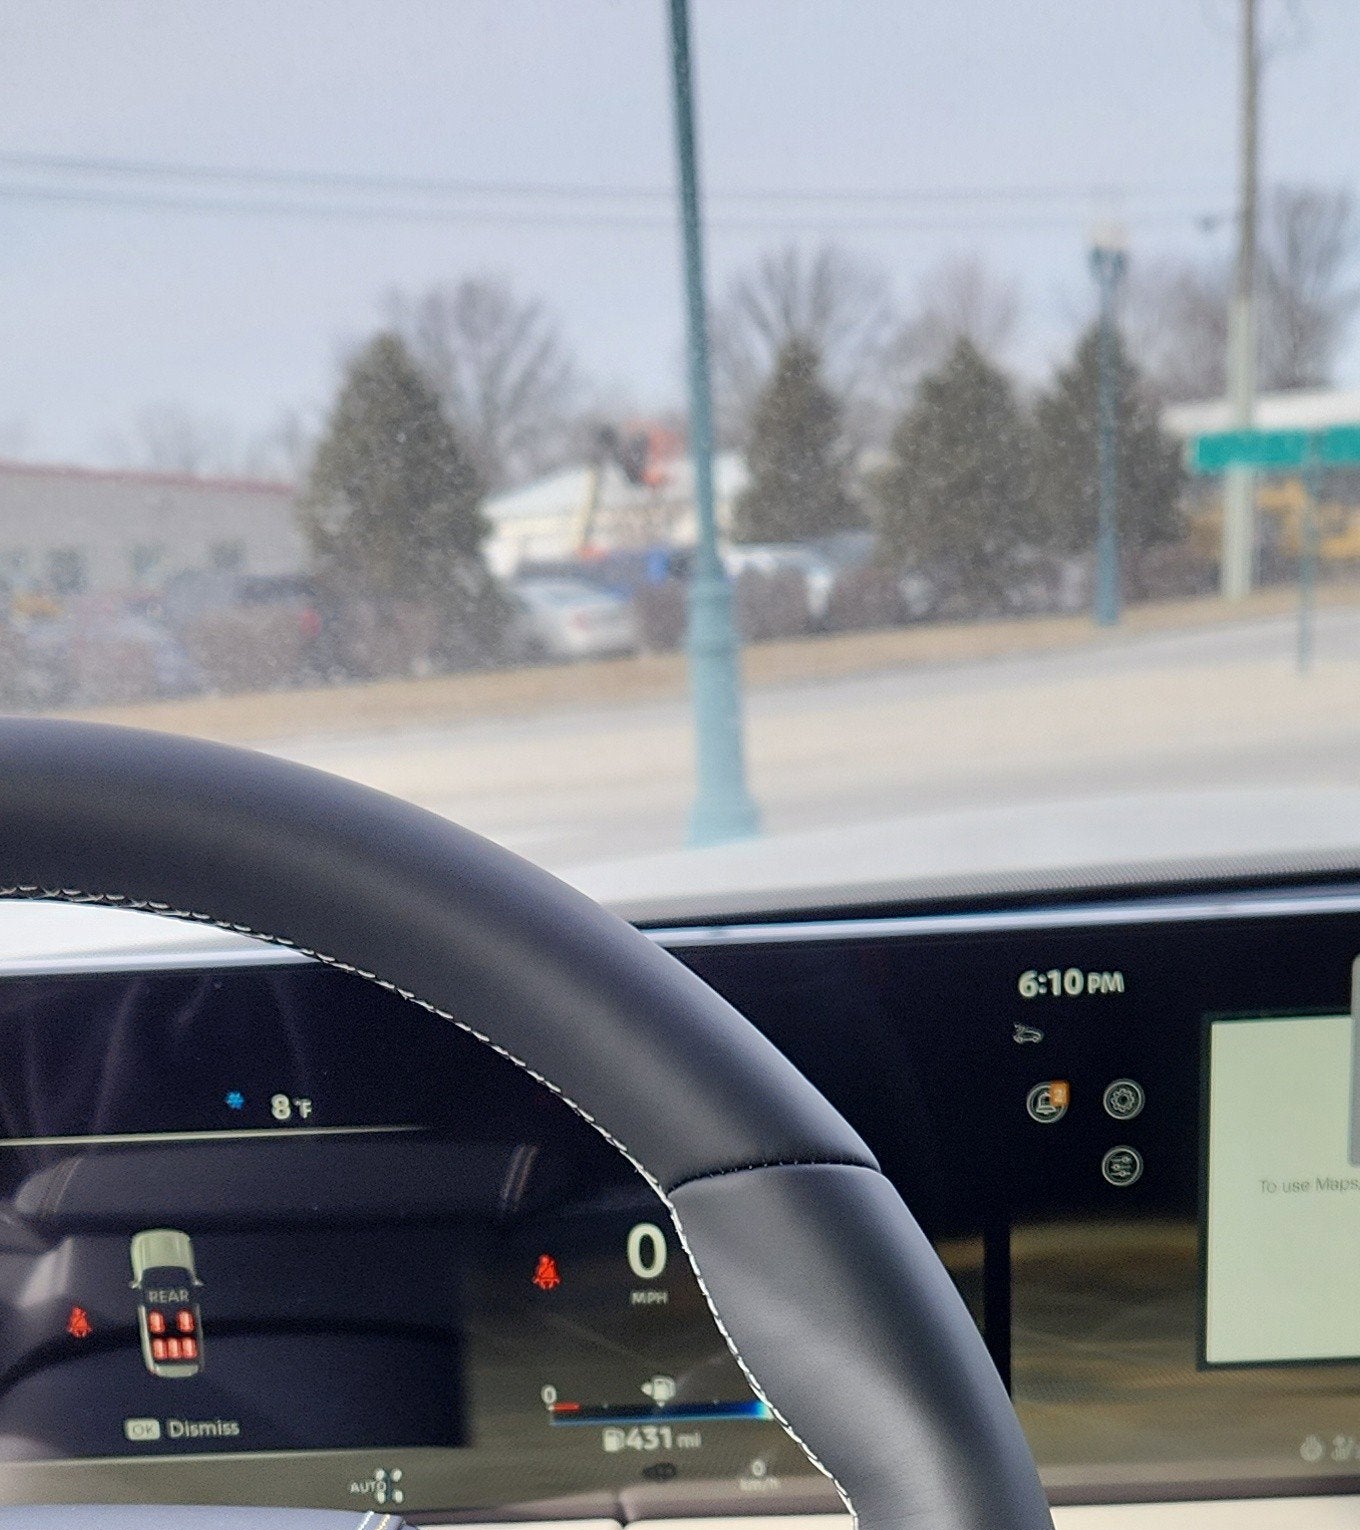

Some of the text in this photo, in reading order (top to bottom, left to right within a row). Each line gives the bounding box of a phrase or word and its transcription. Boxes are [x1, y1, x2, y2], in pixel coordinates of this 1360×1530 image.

[1018, 967, 1125, 998] 6:10 PM
[1259, 1179, 1277, 1194] To
[1282, 1180, 1311, 1193] use
[627, 1223, 667, 1278] 0
[148, 1290, 190, 1302] REAR
[632, 1291, 669, 1305] MPH
[541, 1385, 557, 1405] 0
[167, 1418, 241, 1439] Dismiss
[627, 1426, 701, 1450] 431 mi
[349, 1481, 387, 1494] AUTO
